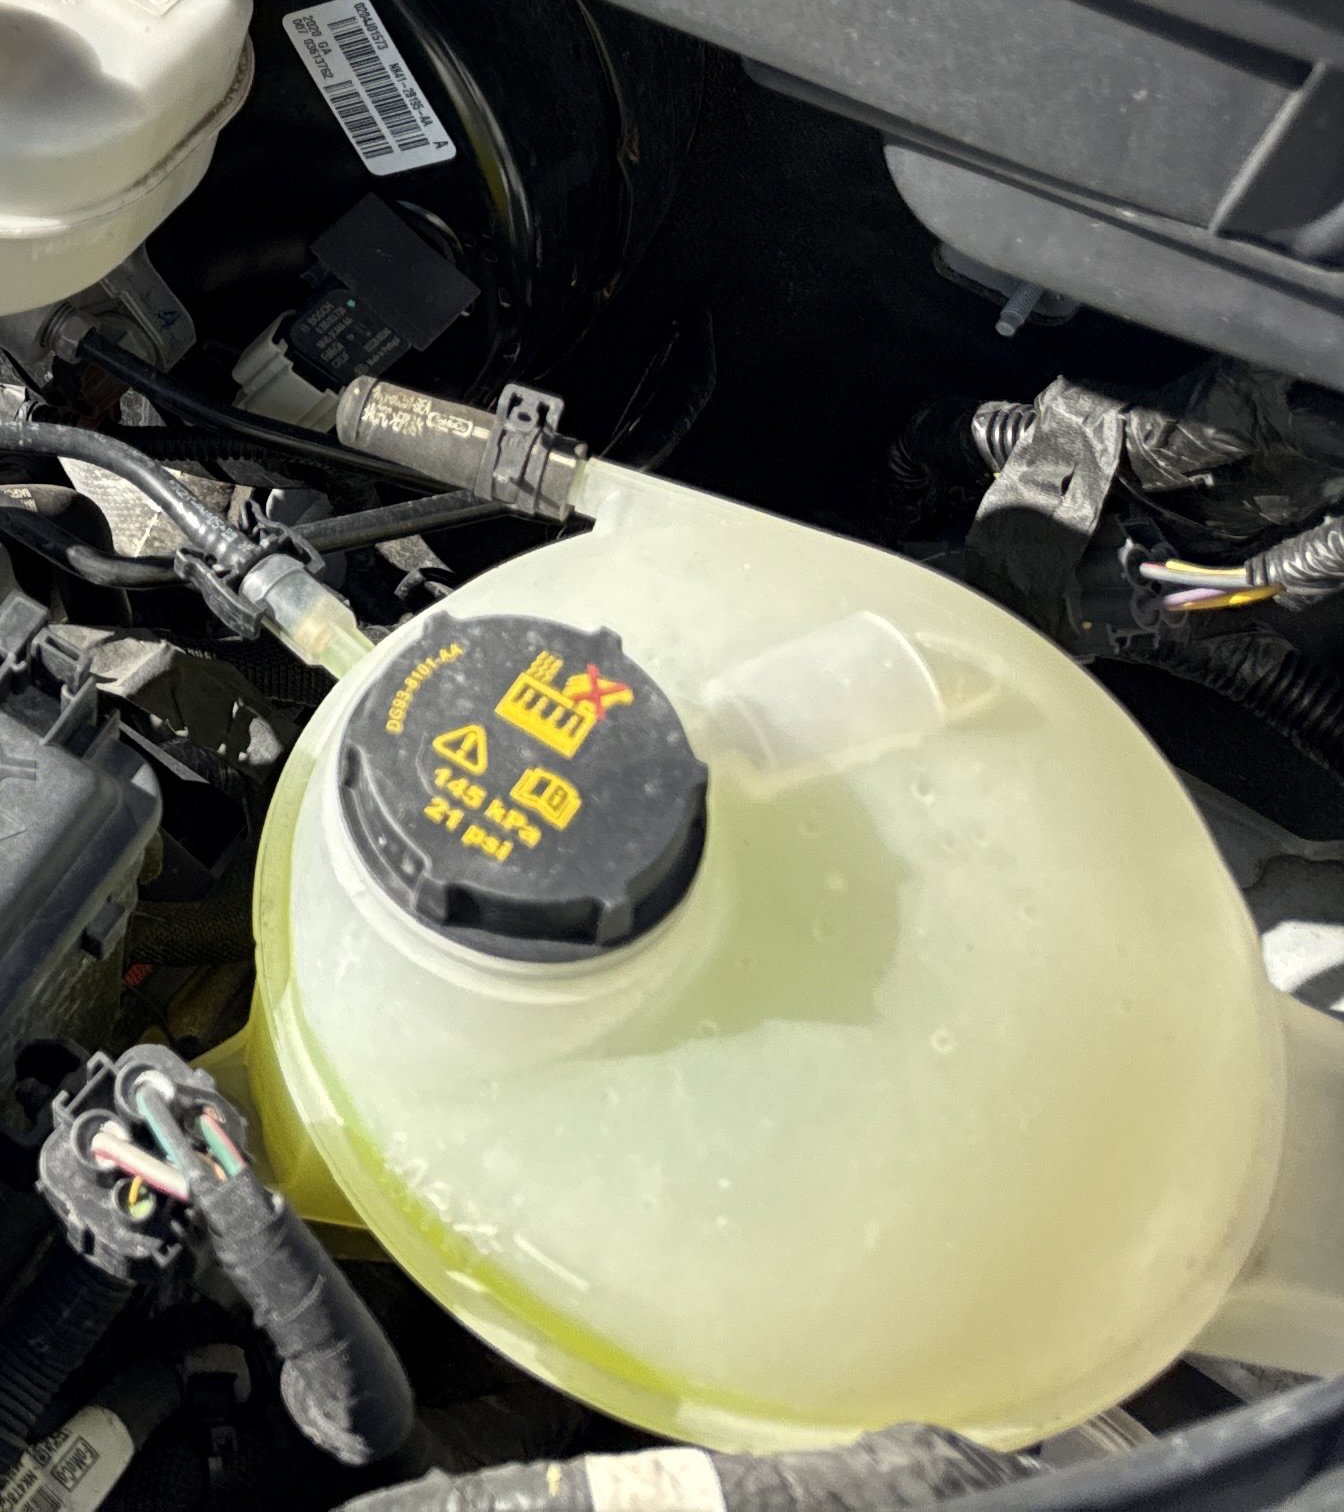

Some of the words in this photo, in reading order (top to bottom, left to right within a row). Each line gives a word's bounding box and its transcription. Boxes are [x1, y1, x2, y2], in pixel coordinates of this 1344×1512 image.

[318, 41, 333, 56] GA
[433, 140, 449, 149] A
[424, 798, 465, 832] 21
[461, 823, 514, 862] psi
[433, 767, 485, 809] 145
[485, 799, 542, 848] kPa
[52, 1438, 94, 1485] FoMoCo
